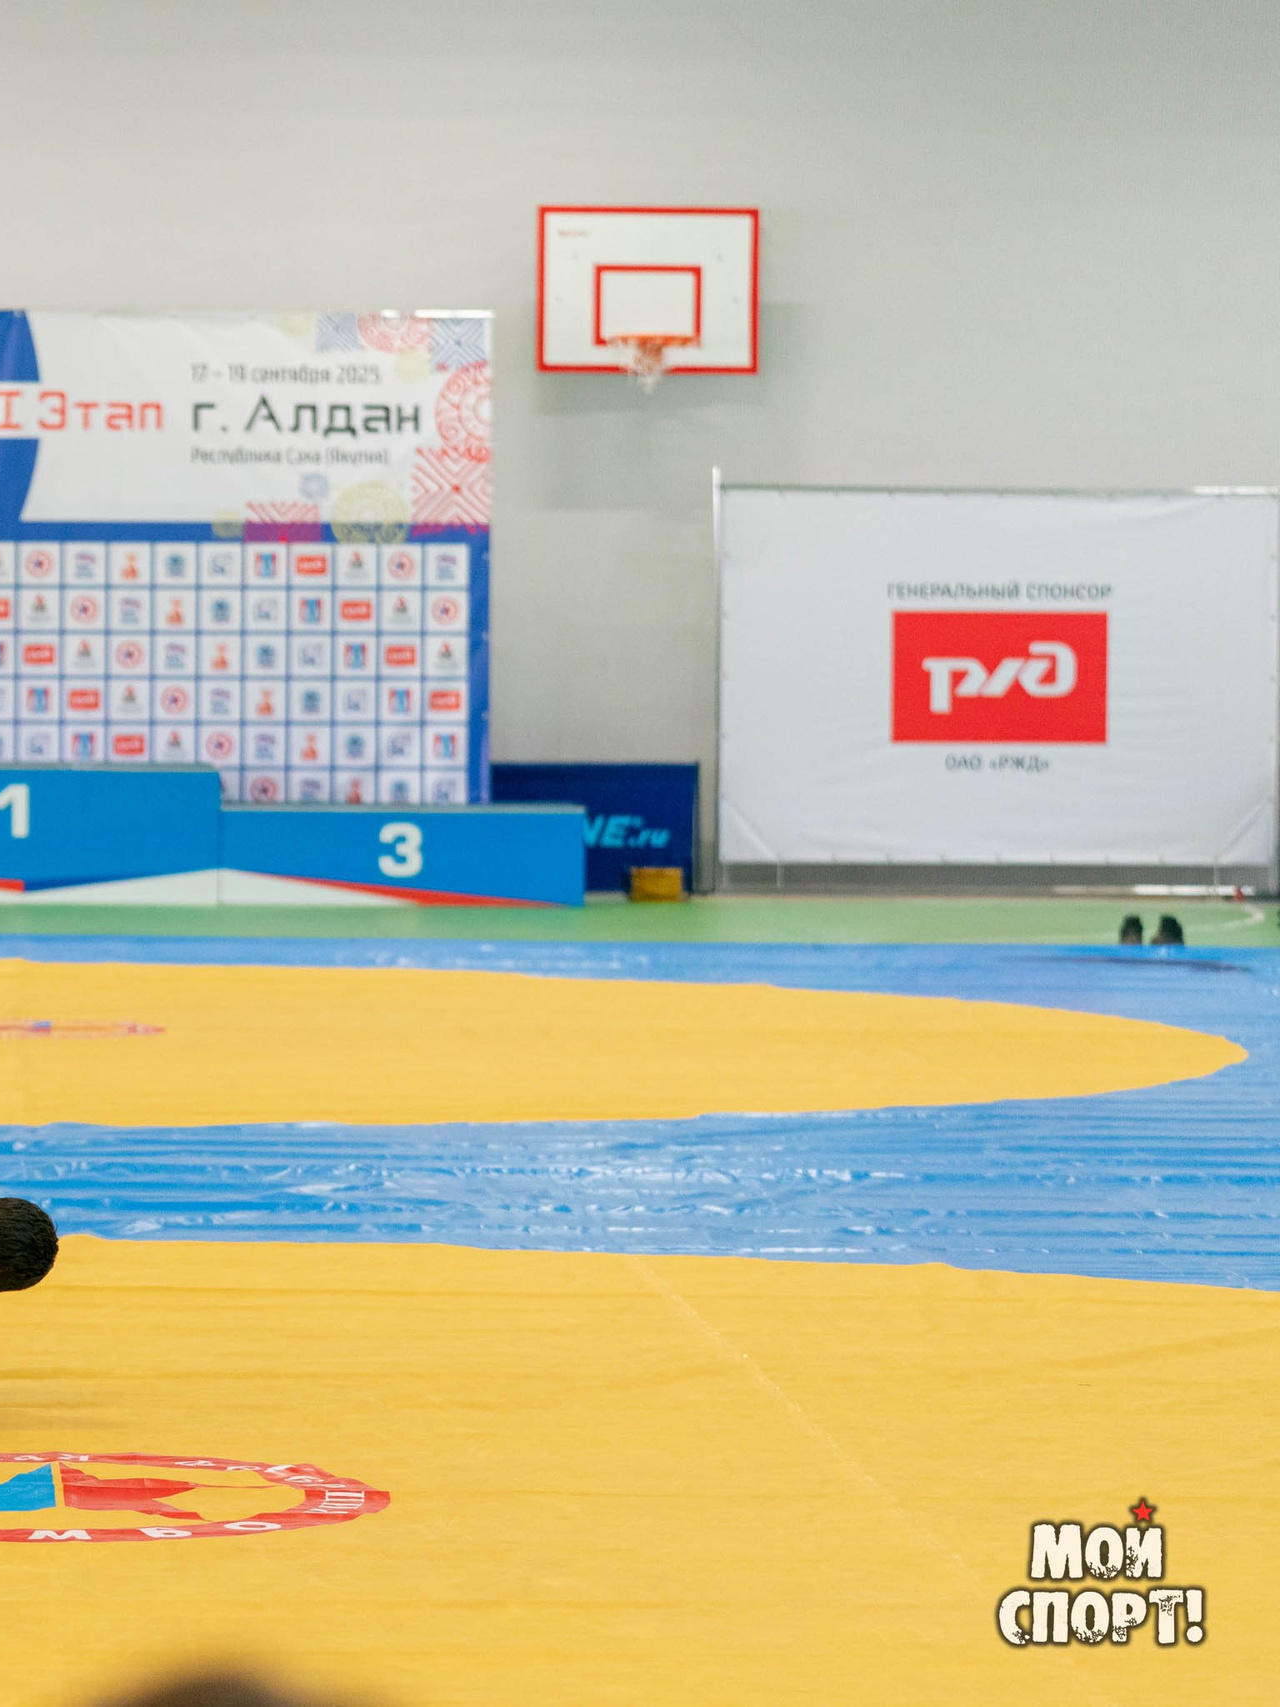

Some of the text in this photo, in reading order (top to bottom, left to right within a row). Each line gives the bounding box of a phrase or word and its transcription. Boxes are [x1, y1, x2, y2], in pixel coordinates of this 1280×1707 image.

[191, 364, 207, 382] 17
[228, 364, 246, 382] 19
[251, 363, 330, 383] сентября
[336, 364, 381, 383] 2025
[193, 395, 420, 437] г. Алдан
[191, 449, 282, 466] Республика
[887, 582, 1111, 599] ГЕНЕРАЛЬНЫЙ СПОНСОР
[945, 754, 1049, 772] ОАО «РЖД»
[378, 822, 424, 878] 3
